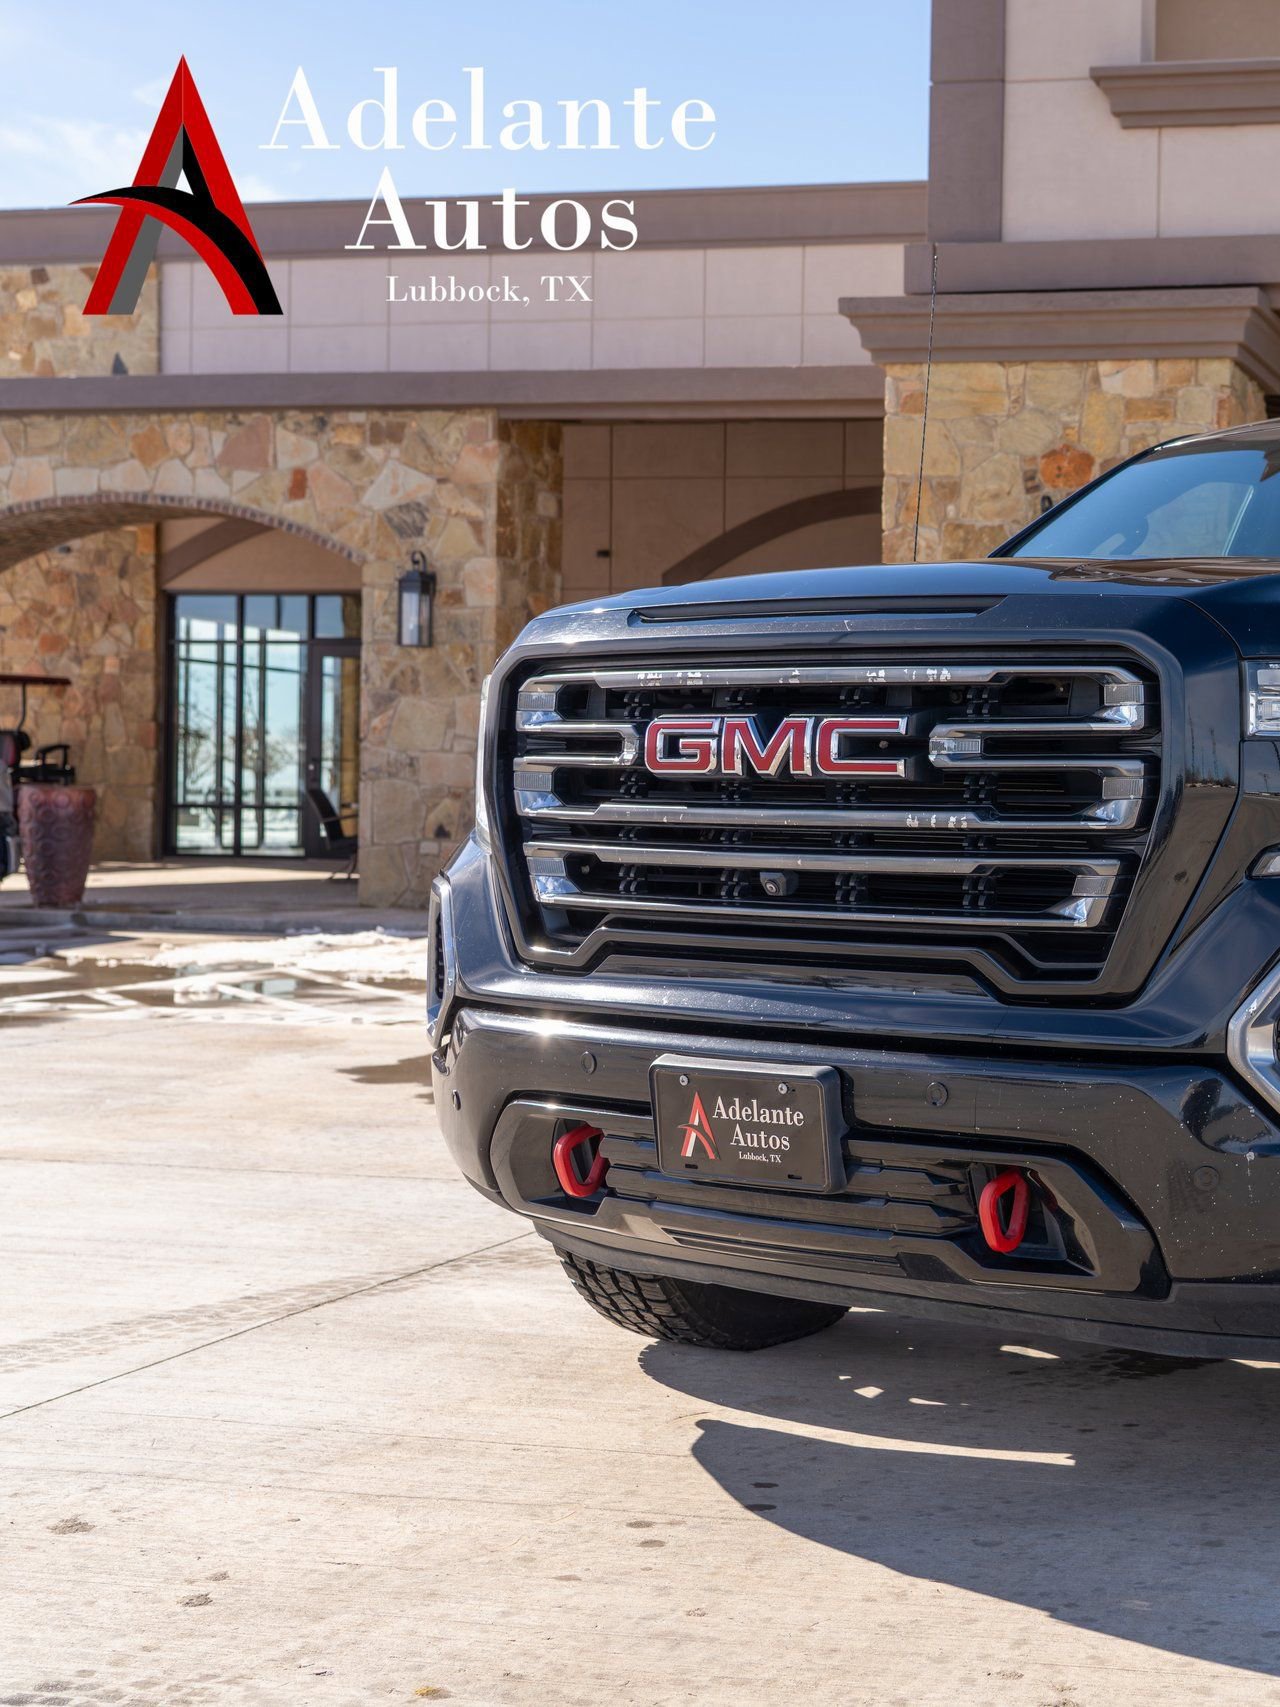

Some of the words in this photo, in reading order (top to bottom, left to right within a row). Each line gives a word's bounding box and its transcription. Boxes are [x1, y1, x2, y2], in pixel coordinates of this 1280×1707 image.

[644, 714, 909, 777] GMC
[712, 1095, 804, 1126] Adelante
[730, 1123, 790, 1151] Autos
[738, 1151, 769, 1163] Lubbock,
[769, 1154, 782, 1163] TX
